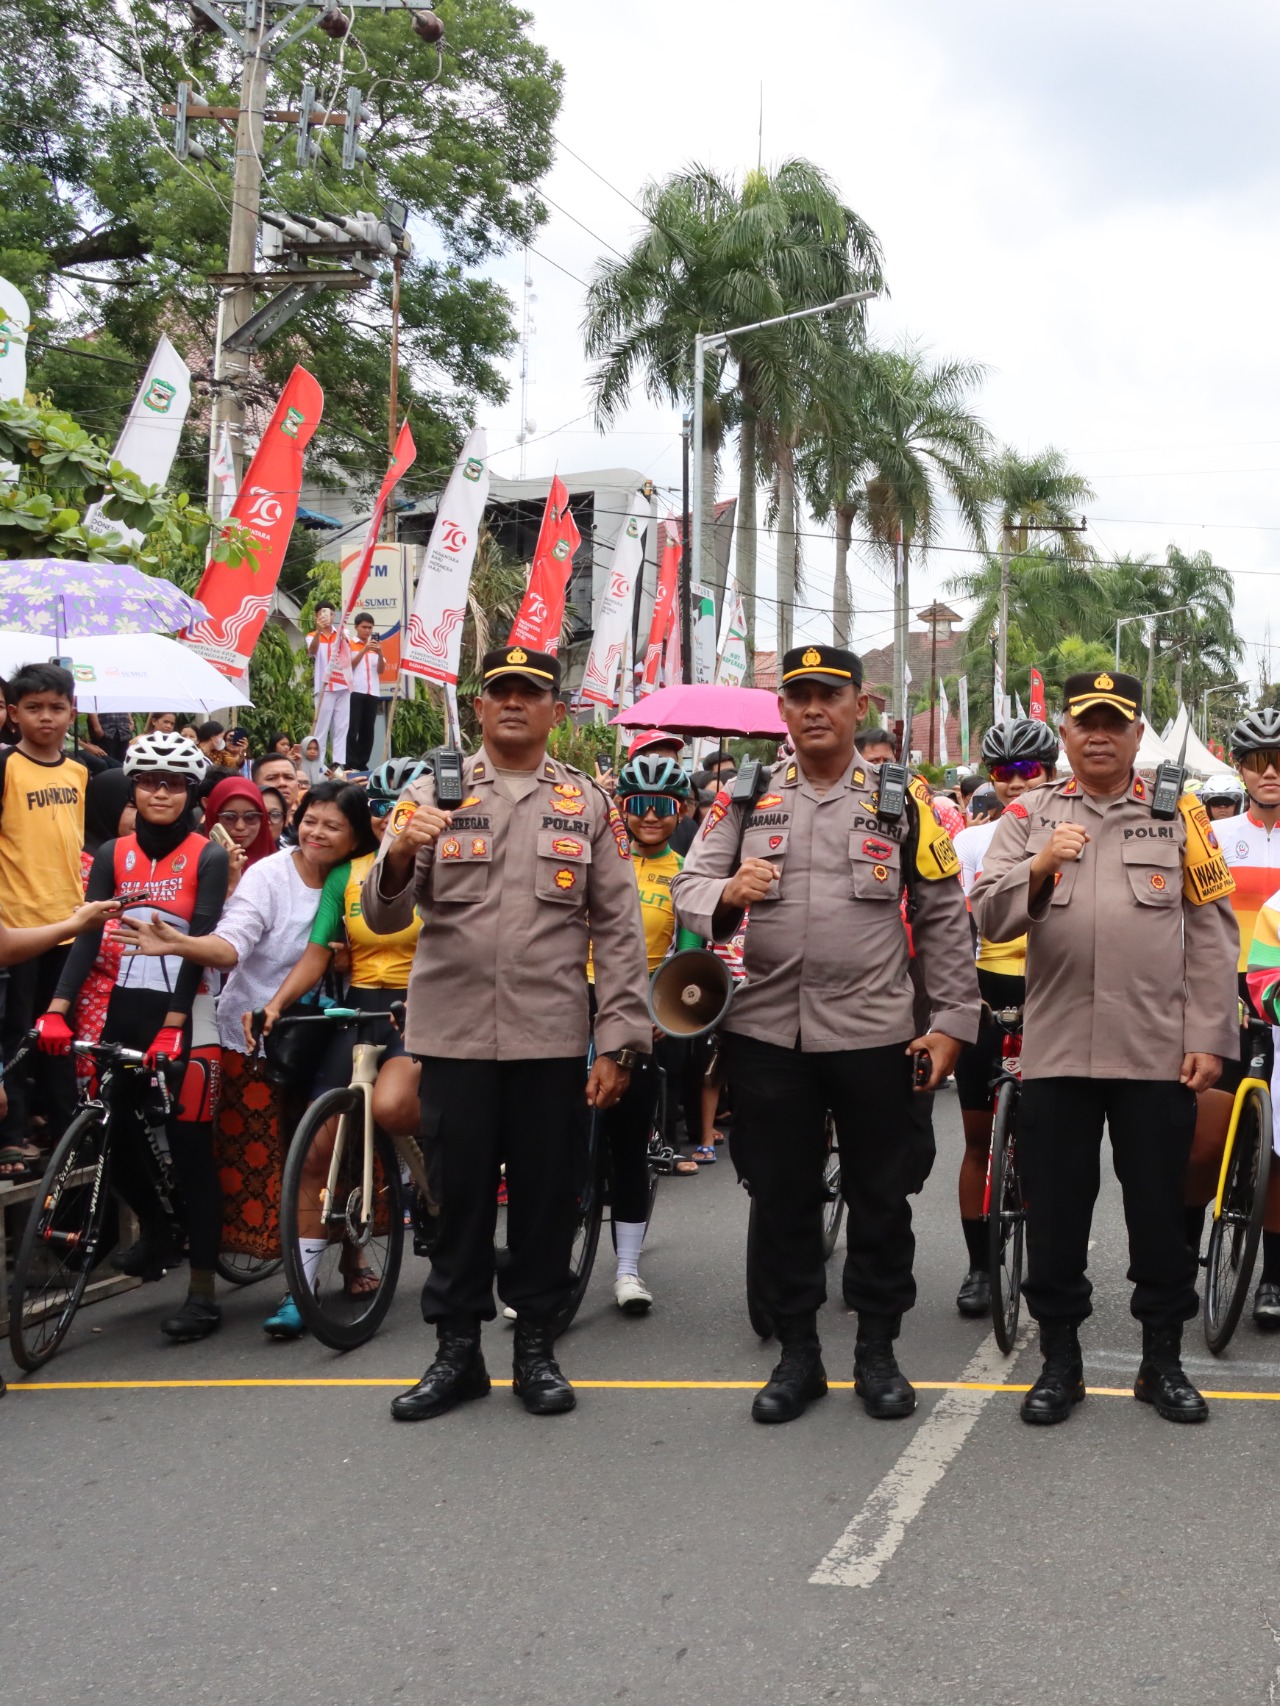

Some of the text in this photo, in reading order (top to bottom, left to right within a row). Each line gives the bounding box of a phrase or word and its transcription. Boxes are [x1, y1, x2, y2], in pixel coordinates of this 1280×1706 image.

[541, 815, 591, 836] POLRI
[854, 815, 903, 840] POLRI
[1123, 826, 1174, 840] POLRI
[1193, 858, 1226, 889] WAKA
[120, 877, 183, 893] SULAWESI
